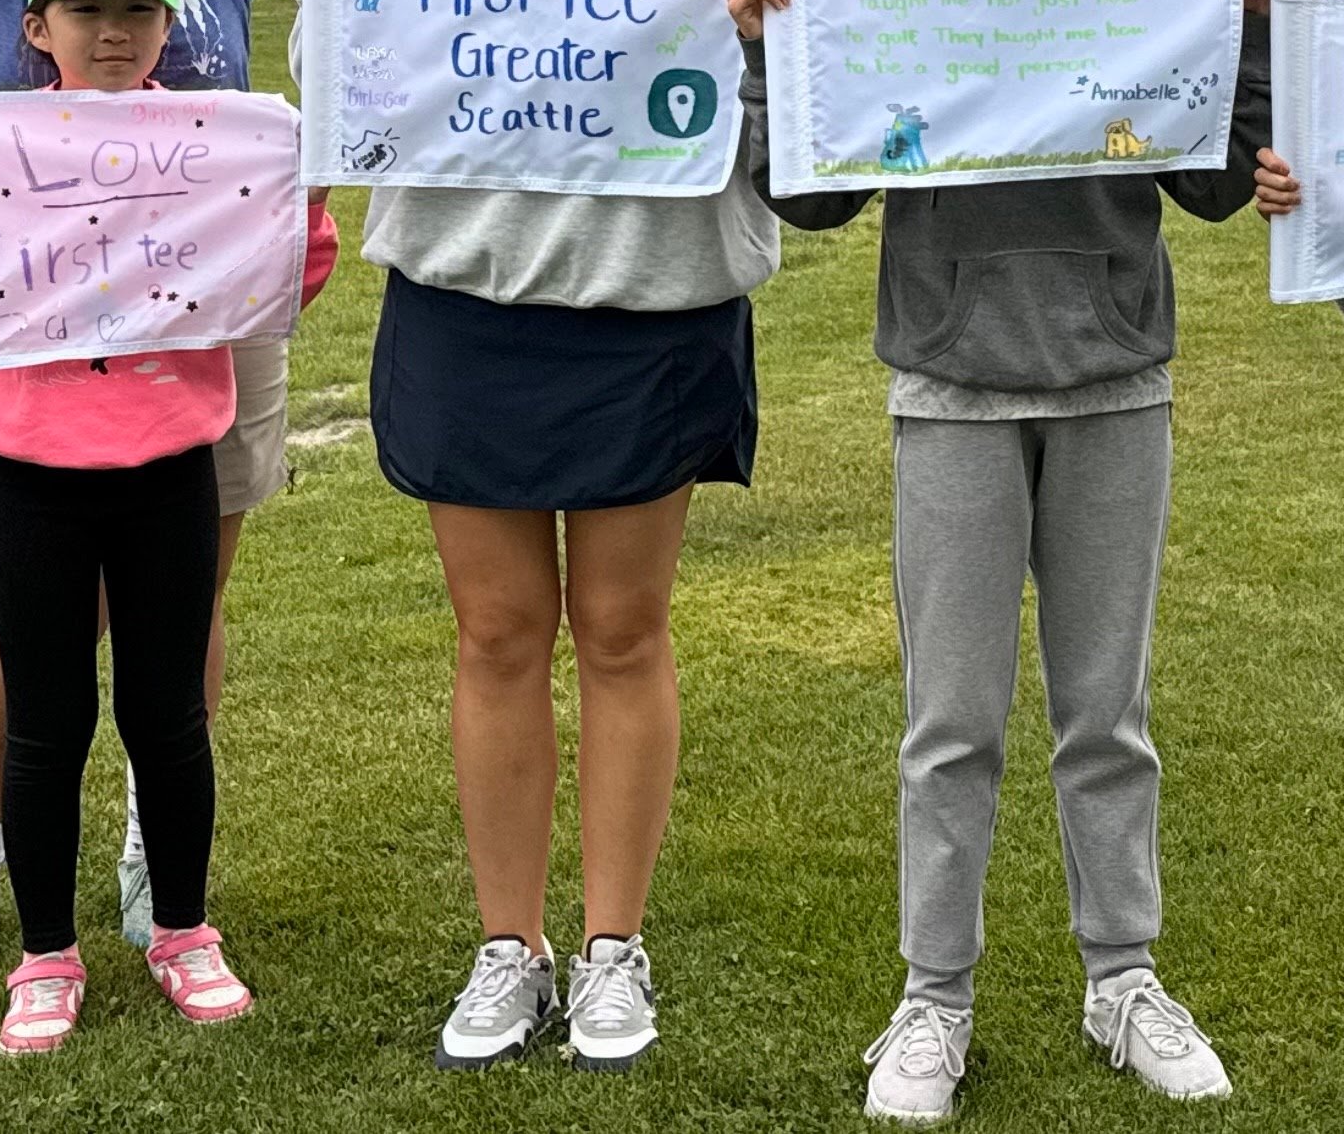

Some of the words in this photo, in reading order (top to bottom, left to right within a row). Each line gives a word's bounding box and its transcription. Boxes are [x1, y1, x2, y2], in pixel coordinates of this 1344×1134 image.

[1065, 28, 1097, 41] me
[451, 32, 628, 83] Greater
[1090, 81, 1181, 102] Annabelle
[449, 91, 613, 139] Seattle
[138, 234, 199, 271] tee
